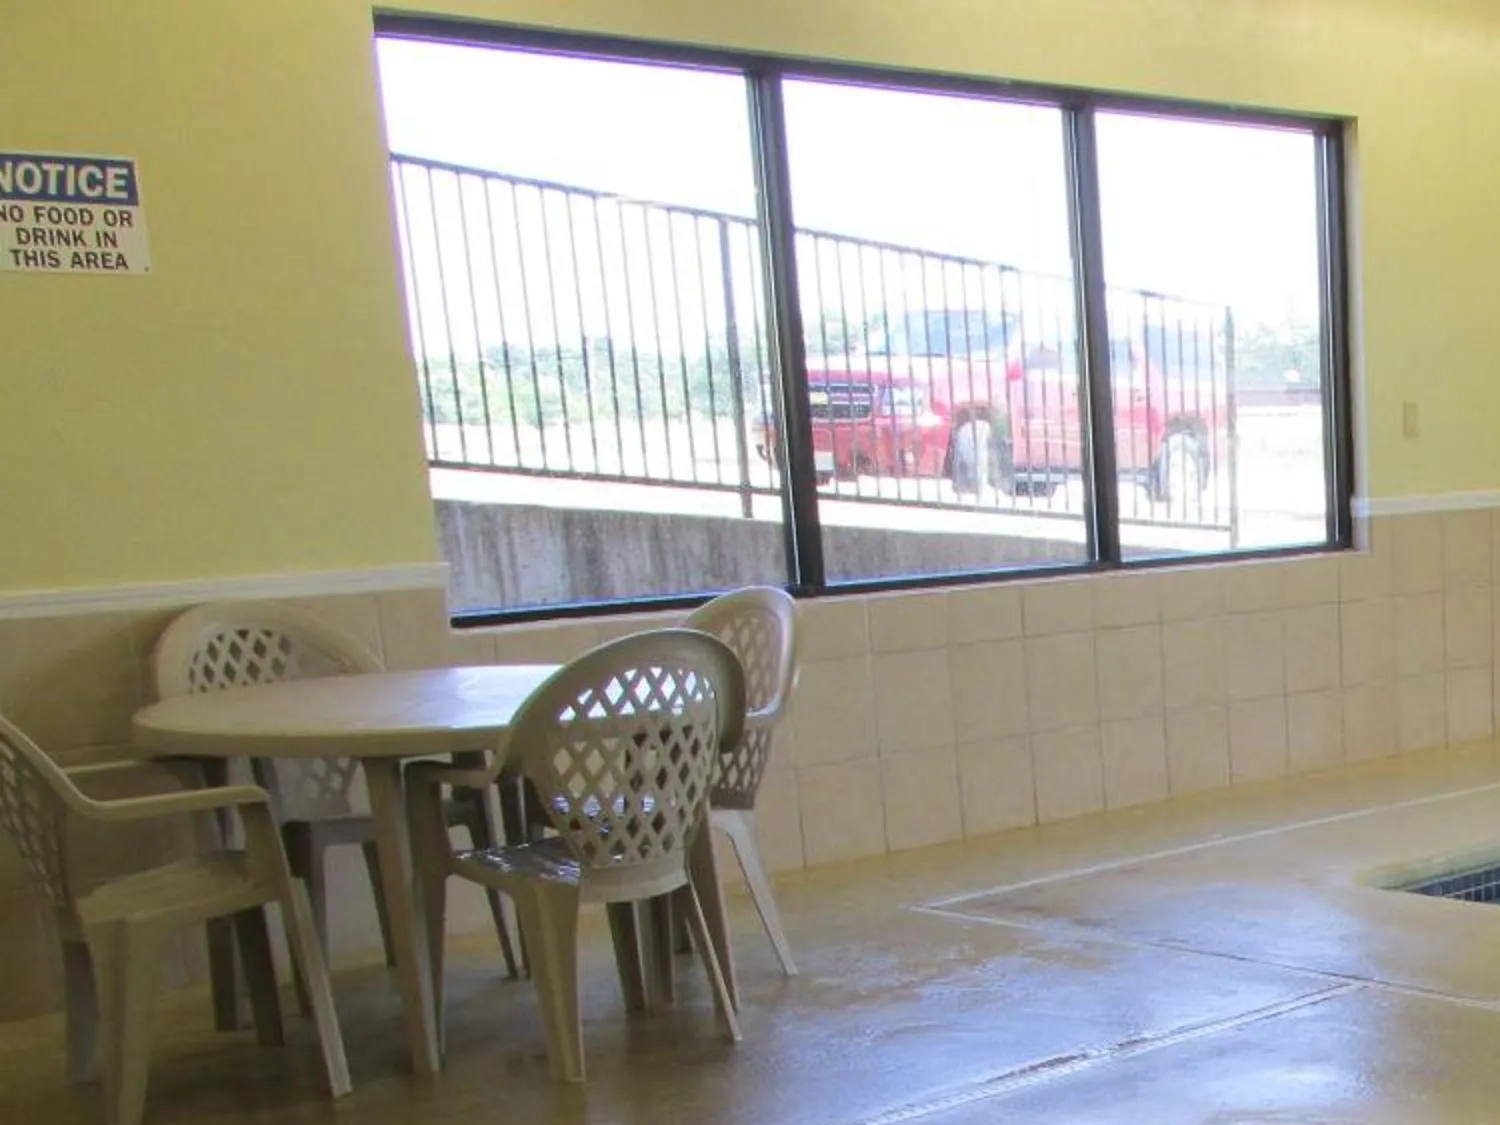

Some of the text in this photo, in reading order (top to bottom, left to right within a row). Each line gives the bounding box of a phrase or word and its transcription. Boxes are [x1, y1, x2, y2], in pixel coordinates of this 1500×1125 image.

[33, 205, 94, 227] FOOD
[103, 209, 133, 227] OR
[16, 226, 118, 248] DRINK IN
[10, 248, 129, 270] THIS AREA
